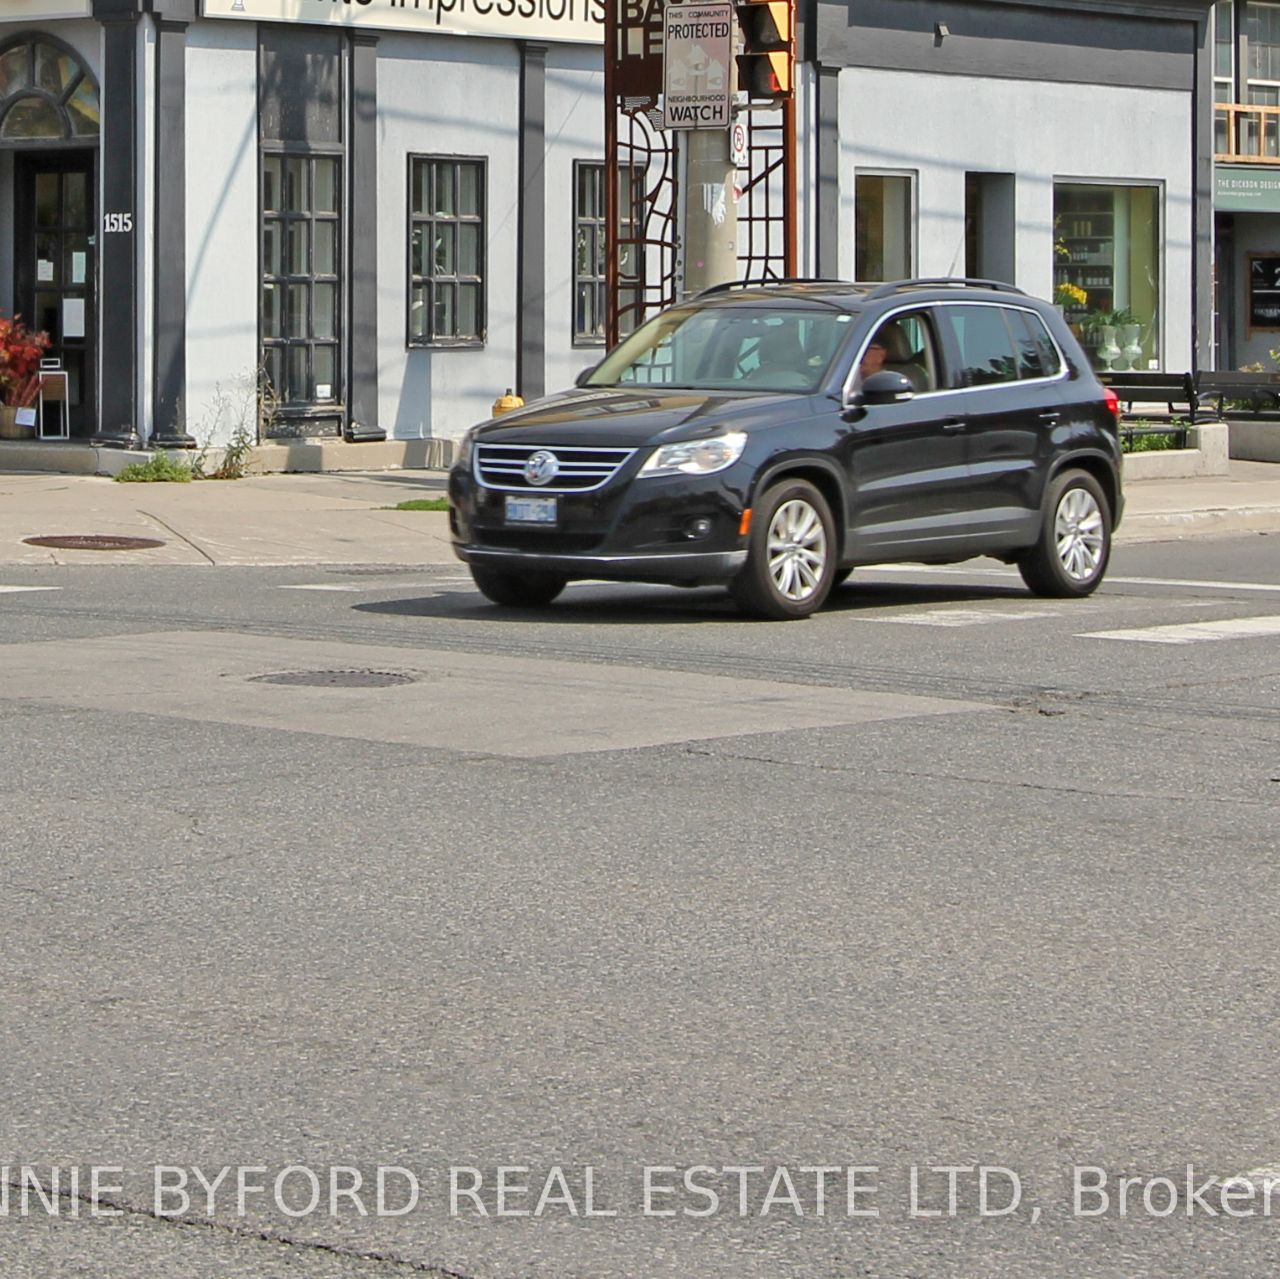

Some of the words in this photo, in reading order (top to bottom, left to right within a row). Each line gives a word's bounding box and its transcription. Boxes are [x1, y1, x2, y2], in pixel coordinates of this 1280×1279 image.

[668, 11, 683, 19] THIS
[688, 9, 729, 19] COMMUNITY
[668, 22, 729, 40] PROTECTED
[668, 94, 727, 103] NEIGHBOURHOOD
[670, 104, 724, 122] WATCH
[103, 212, 133, 233] 1515
